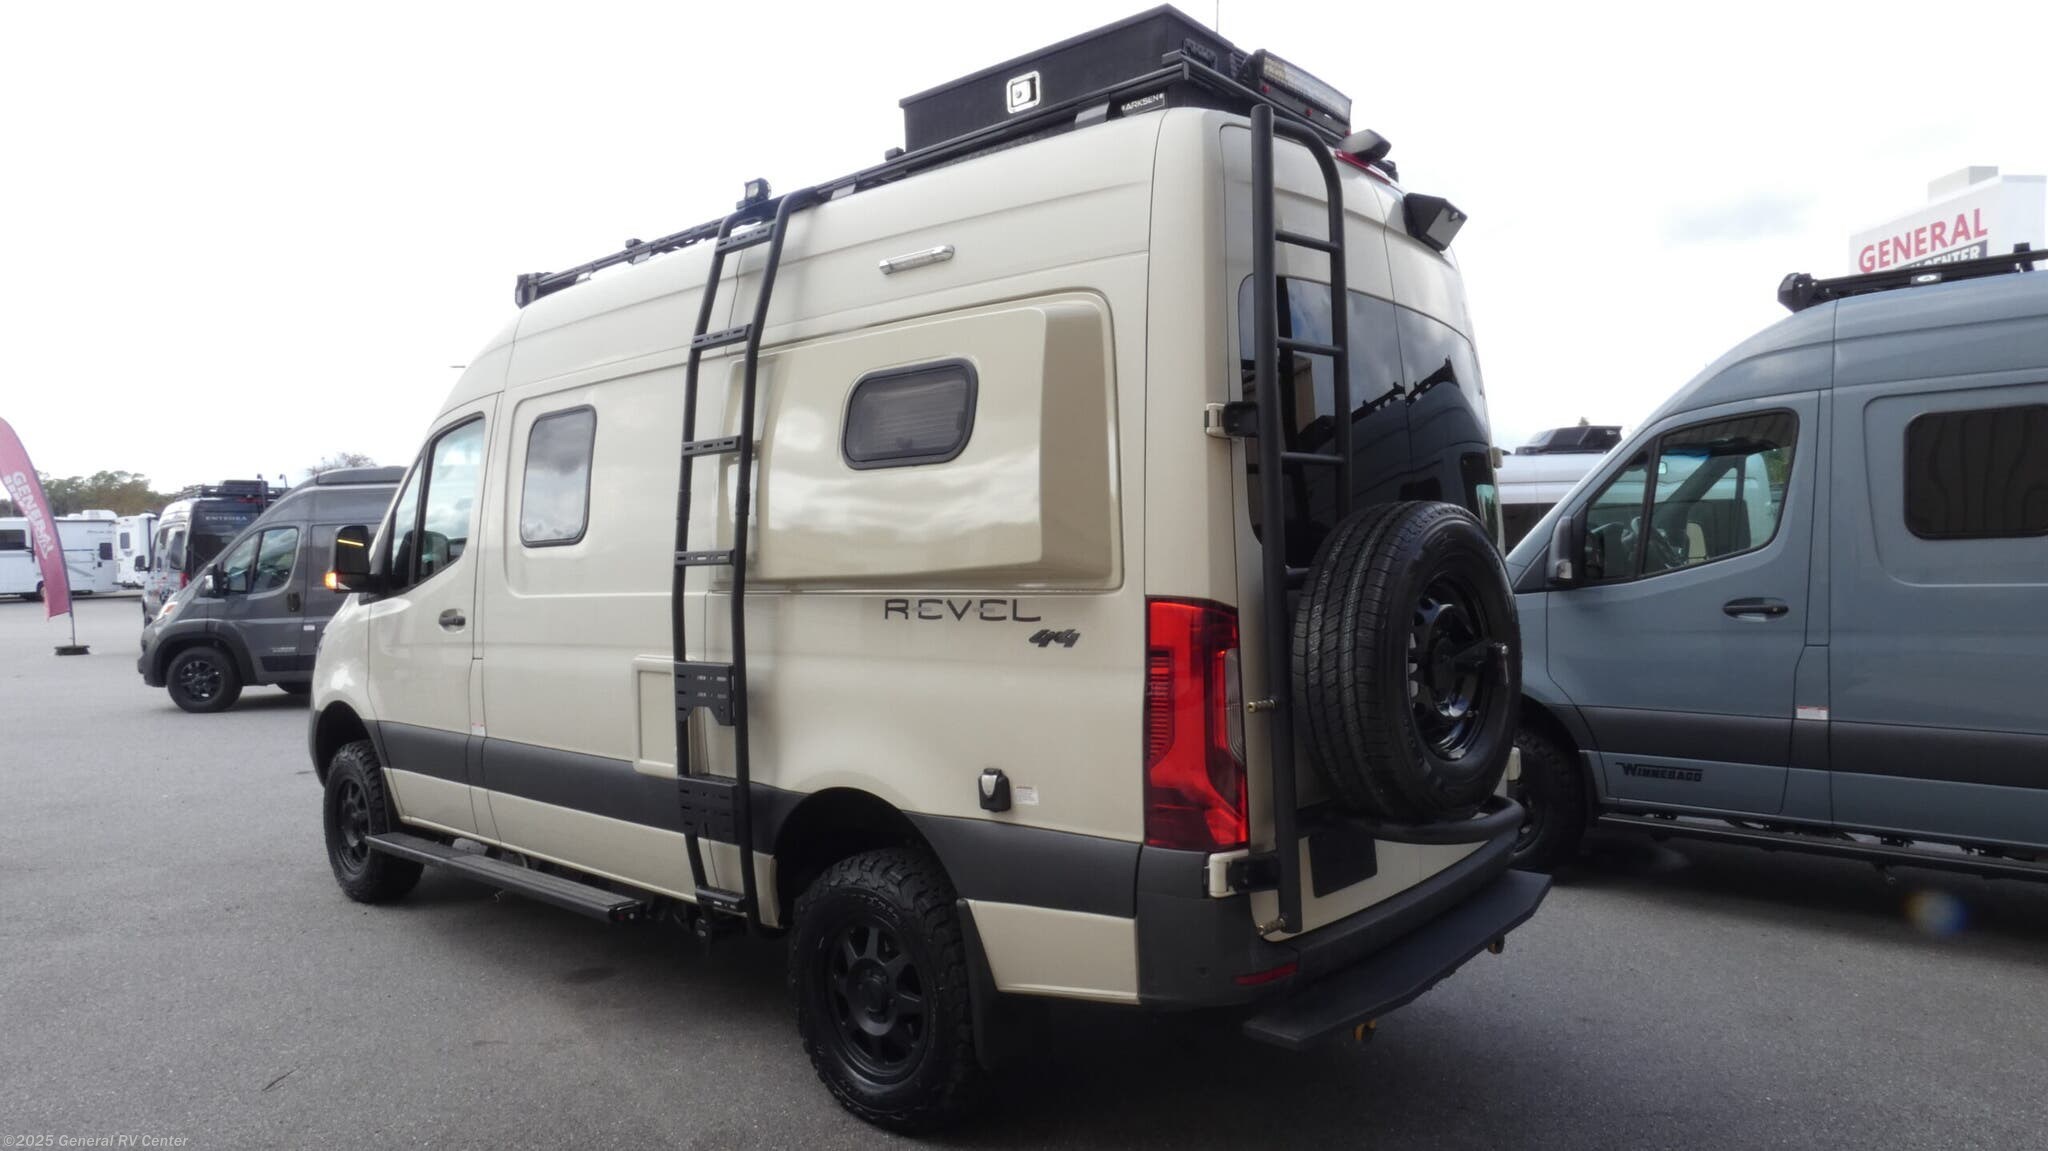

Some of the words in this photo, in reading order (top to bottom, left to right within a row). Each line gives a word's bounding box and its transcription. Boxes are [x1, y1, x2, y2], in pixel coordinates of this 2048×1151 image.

[1859, 208, 1988, 274] GENERAL
[13, 471, 54, 560] GENERAL
[885, 598, 1041, 622] REVEL
